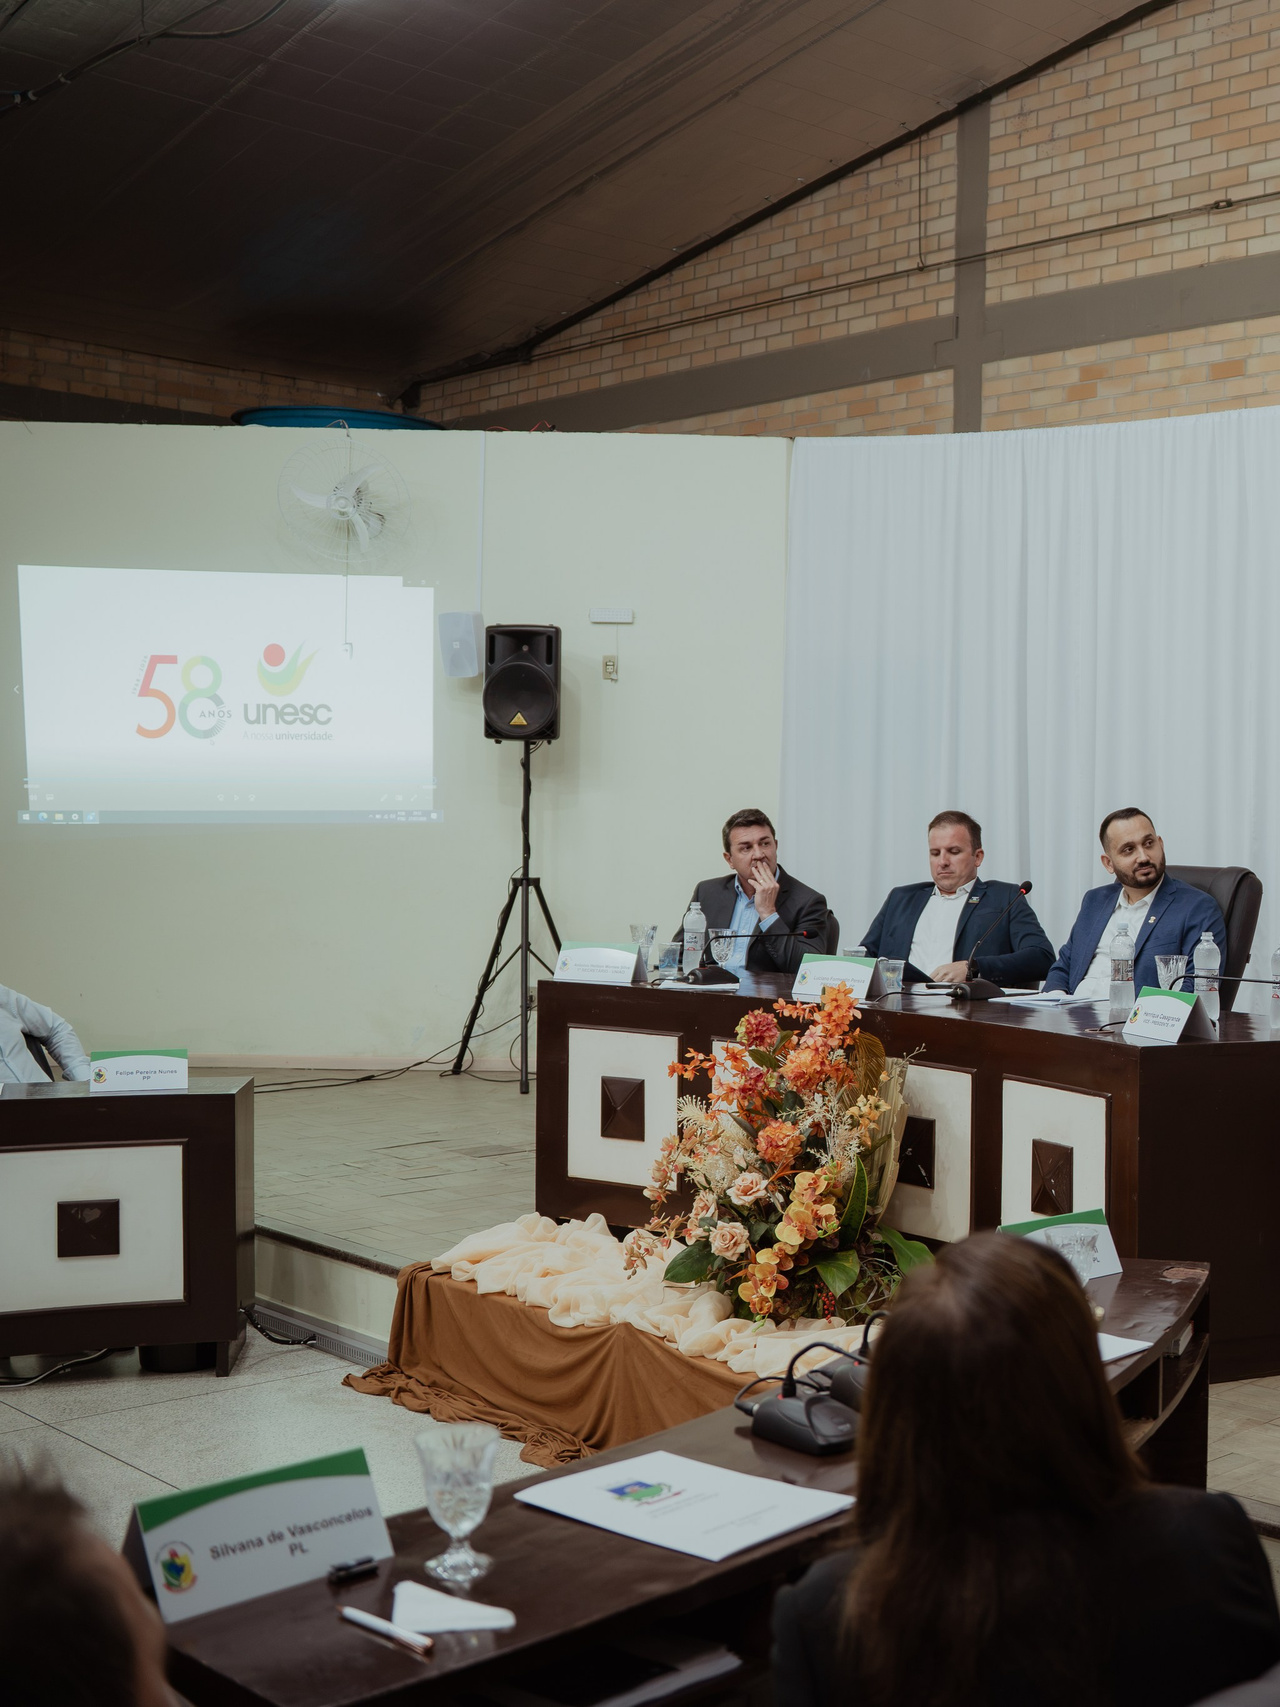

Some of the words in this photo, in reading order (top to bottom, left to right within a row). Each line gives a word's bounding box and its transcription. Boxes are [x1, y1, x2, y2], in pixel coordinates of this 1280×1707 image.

[135, 654, 225, 740] 58
[198, 709, 233, 720] ANOS
[243, 703, 333, 726] unesc
[250, 731, 274, 741] nossa
[209, 1537, 264, 1561] Silvana
[267, 1530, 285, 1544] de
[287, 1507, 373, 1538] Vasconcelos
[289, 1542, 309, 1557] PL
